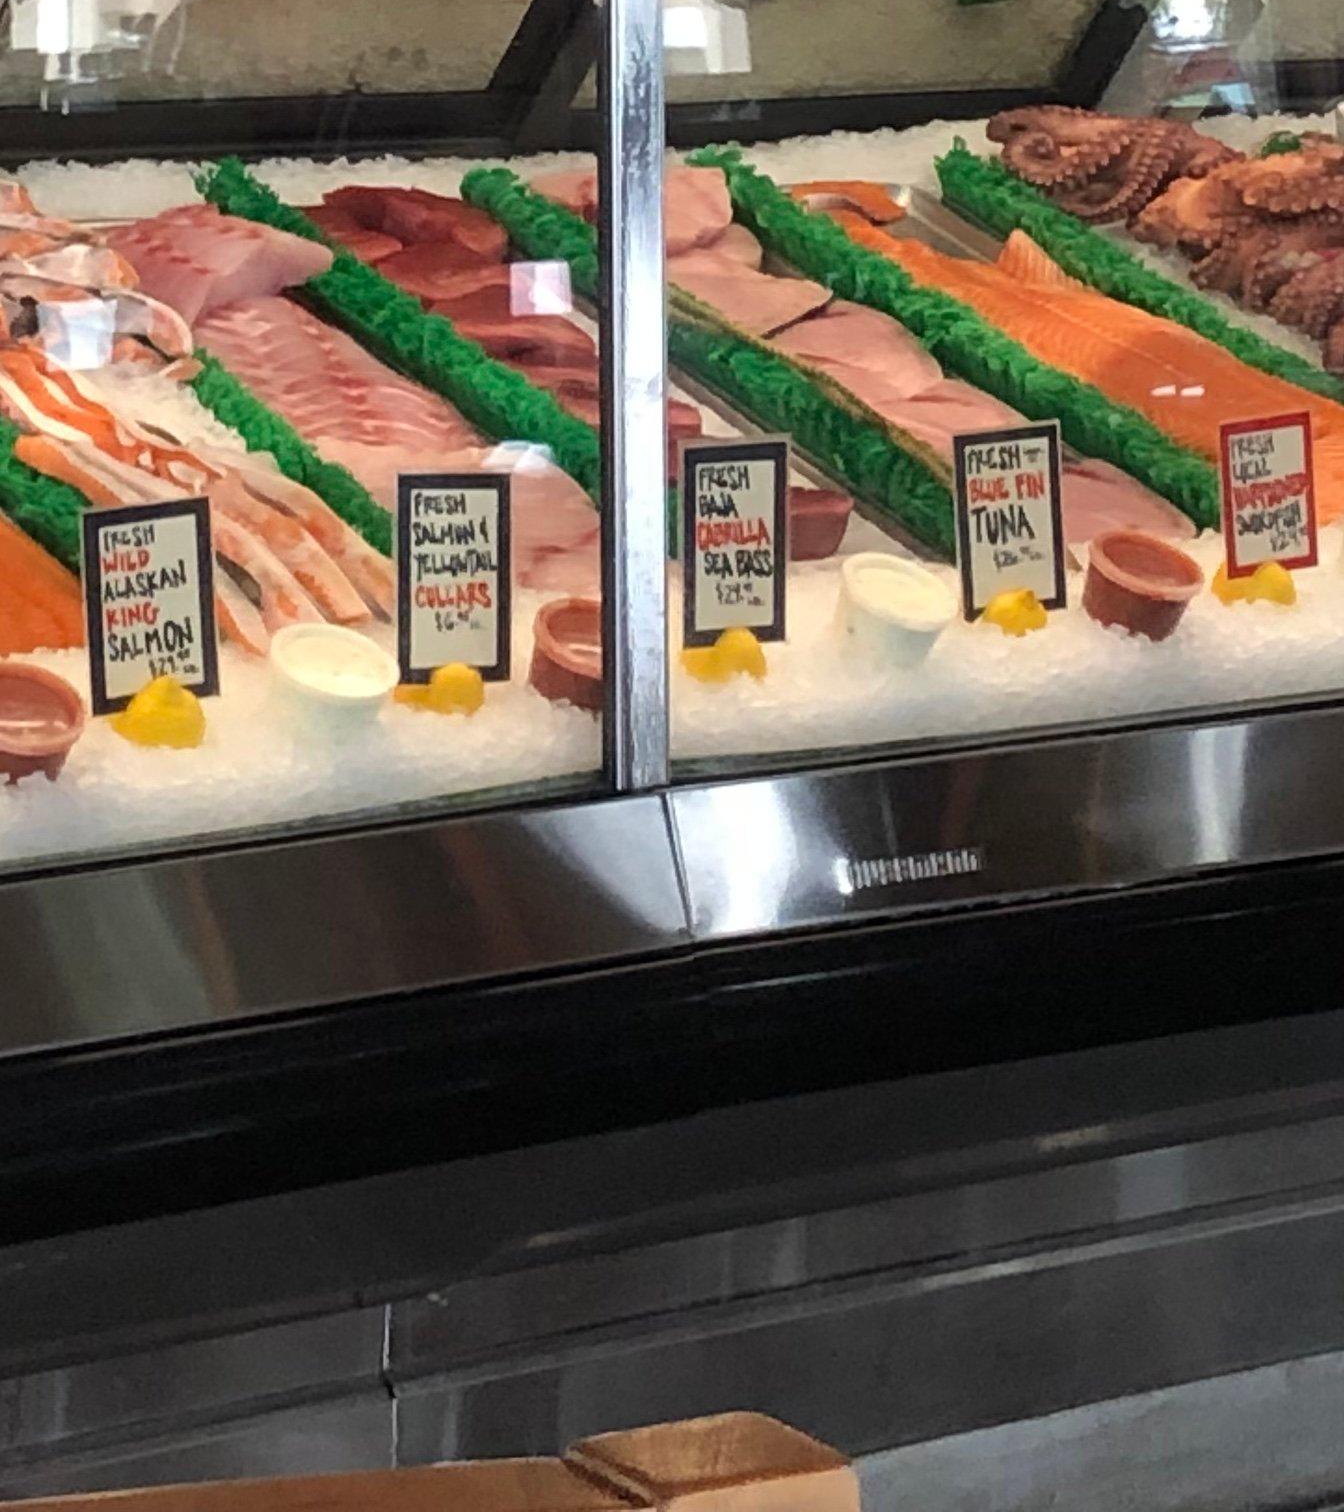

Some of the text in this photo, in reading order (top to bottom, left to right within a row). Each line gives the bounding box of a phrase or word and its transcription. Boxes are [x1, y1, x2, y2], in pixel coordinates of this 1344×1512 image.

[967, 443, 1021, 474] FRESH
[1231, 432, 1275, 461] FRESH
[699, 463, 751, 491] FRESH
[968, 469, 1045, 503] BLUE FIN
[413, 492, 466, 517] FRESH
[699, 492, 739, 519] BAJA
[103, 523, 155, 551] FRESH
[413, 519, 475, 547] SALMON
[971, 504, 1035, 546] TUNA
[102, 549, 150, 573] WILD
[704, 549, 774, 579] SEA BASS
[103, 558, 187, 603] ALASKAN
[106, 601, 160, 631] KING
[108, 616, 194, 663] SALMON
